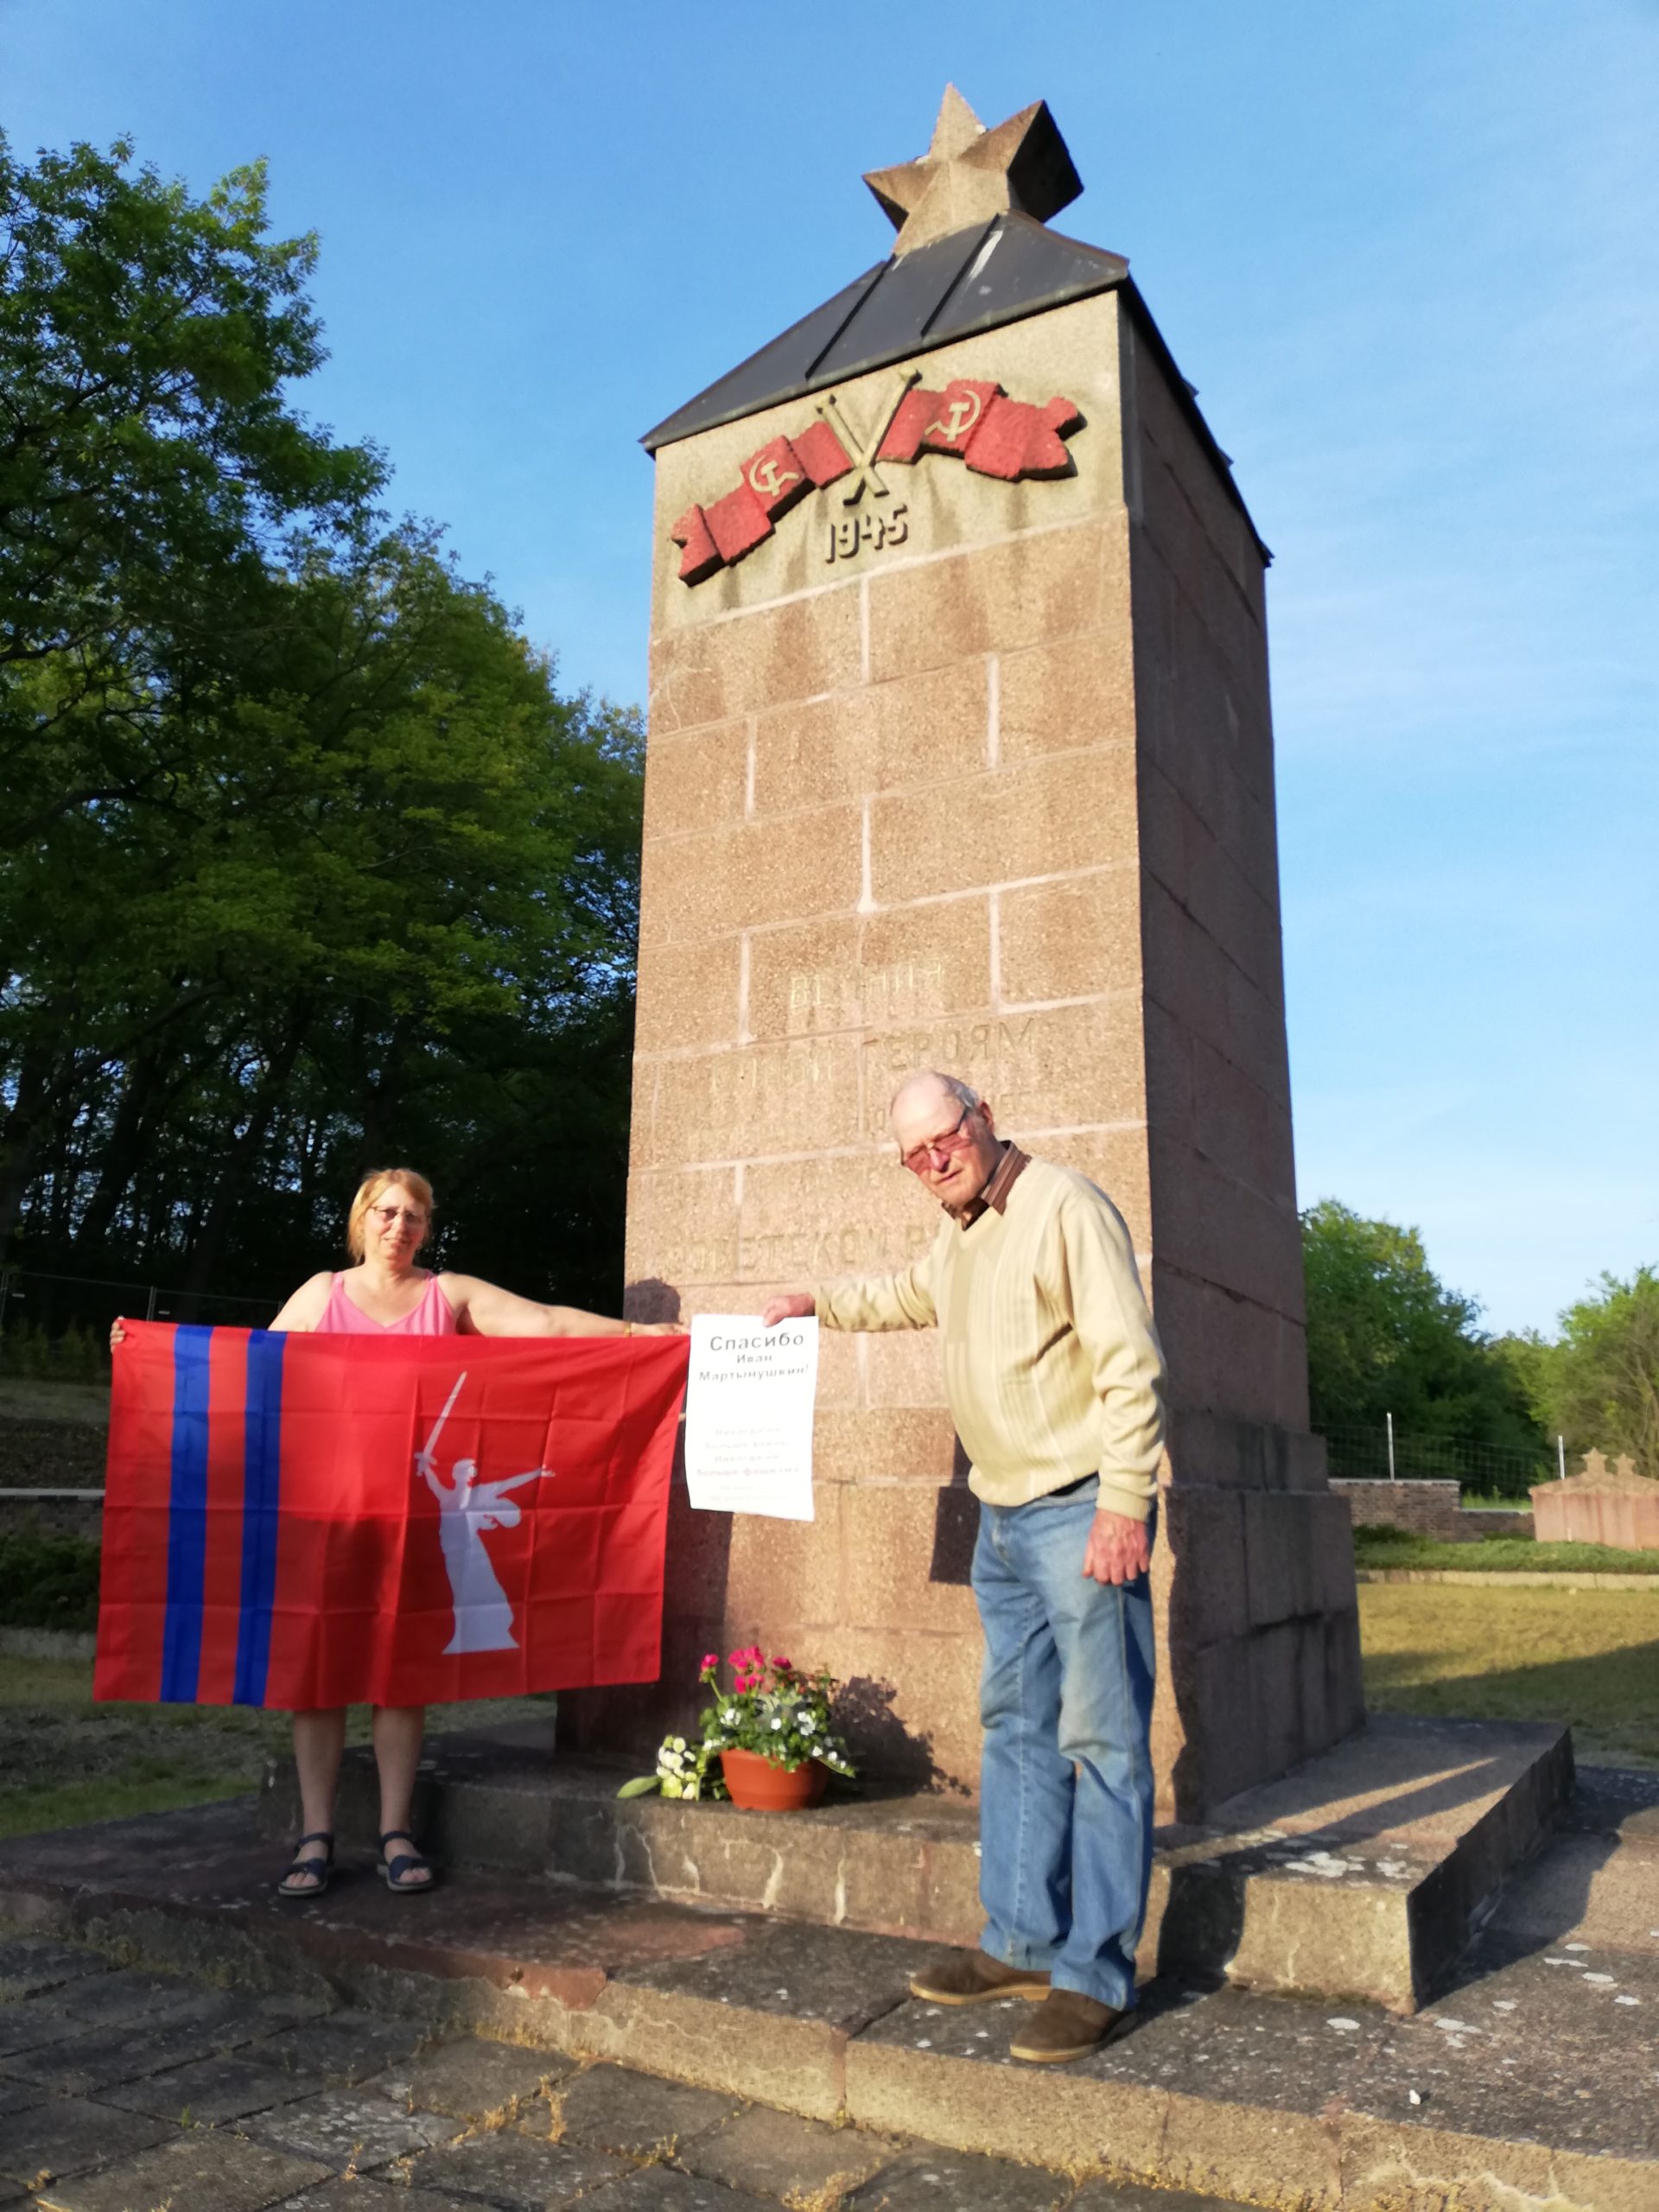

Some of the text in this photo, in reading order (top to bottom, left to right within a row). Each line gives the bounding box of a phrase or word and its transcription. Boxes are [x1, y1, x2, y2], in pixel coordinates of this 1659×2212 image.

[824, 504, 908, 563] 1945
[709, 1332, 804, 1351] Спасибо
[736, 1354, 772, 1364] Иван
[699, 1363, 809, 1382] Мартынушкин!
